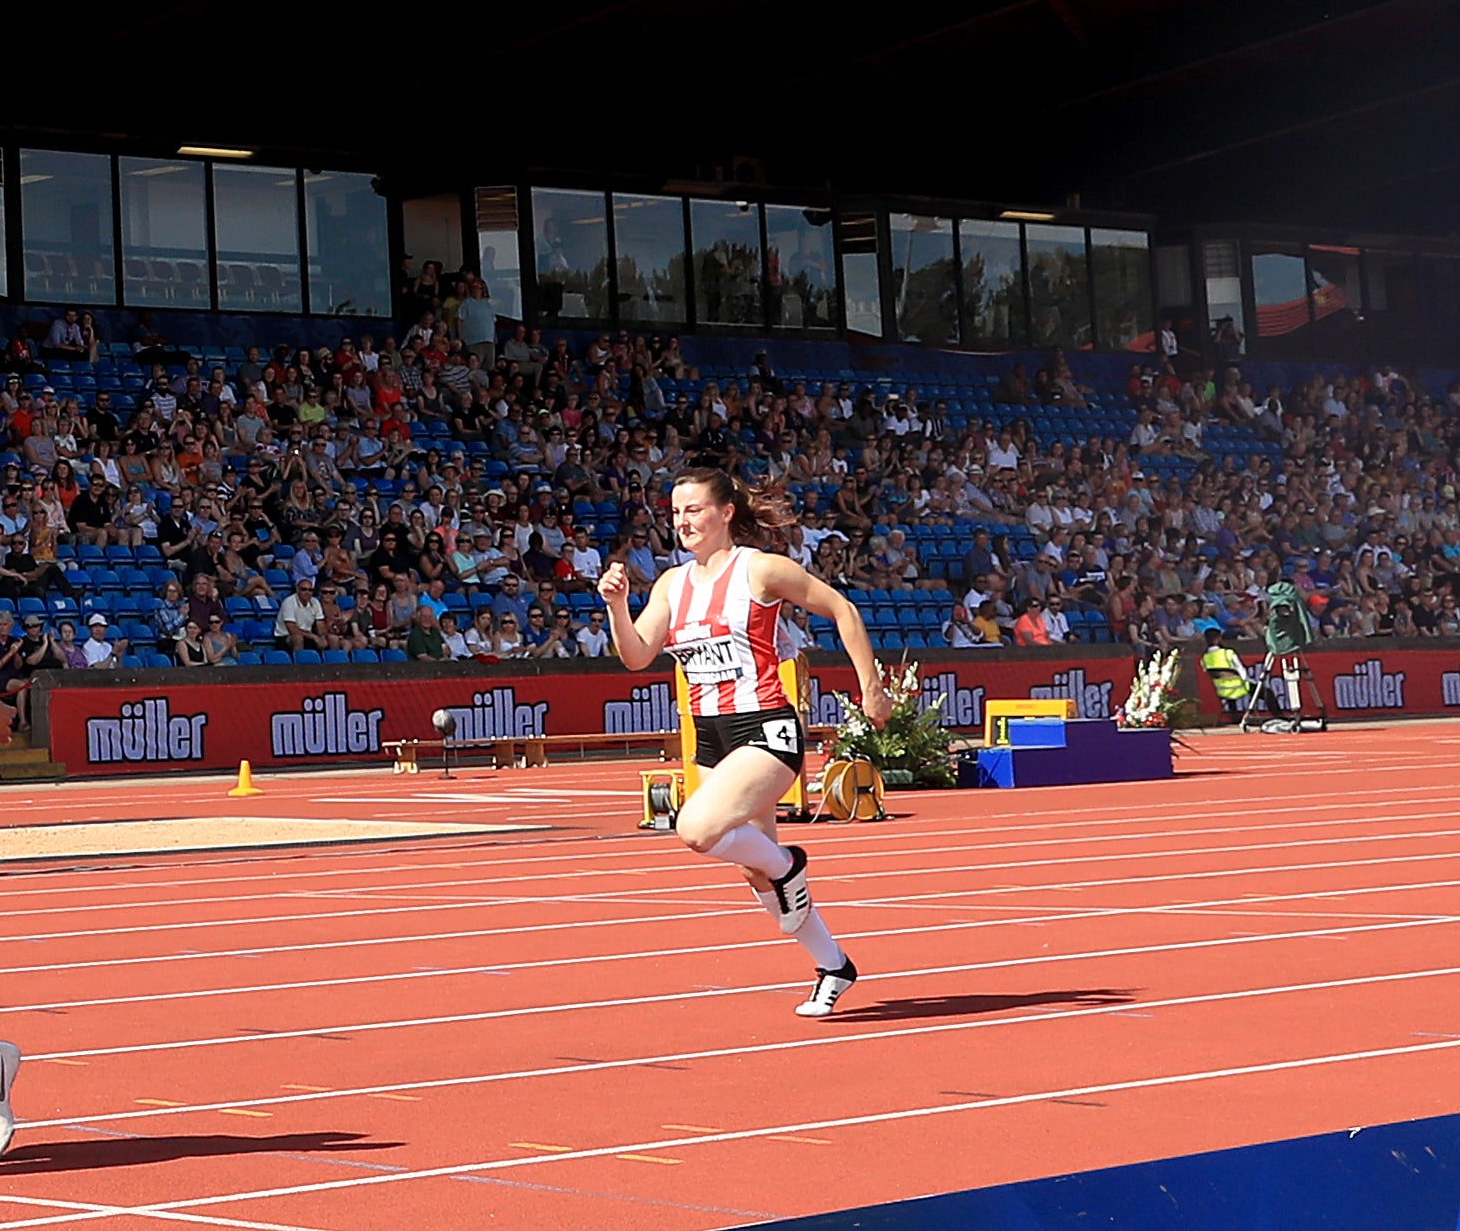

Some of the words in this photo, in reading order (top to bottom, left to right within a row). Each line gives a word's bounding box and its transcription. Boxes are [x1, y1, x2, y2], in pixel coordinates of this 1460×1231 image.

[675, 640, 733, 667] BRYANT
[1334, 660, 1405, 709] müller
[87, 699, 207, 762] müller
[272, 693, 383, 756] müller
[776, 725, 792, 746] 4
